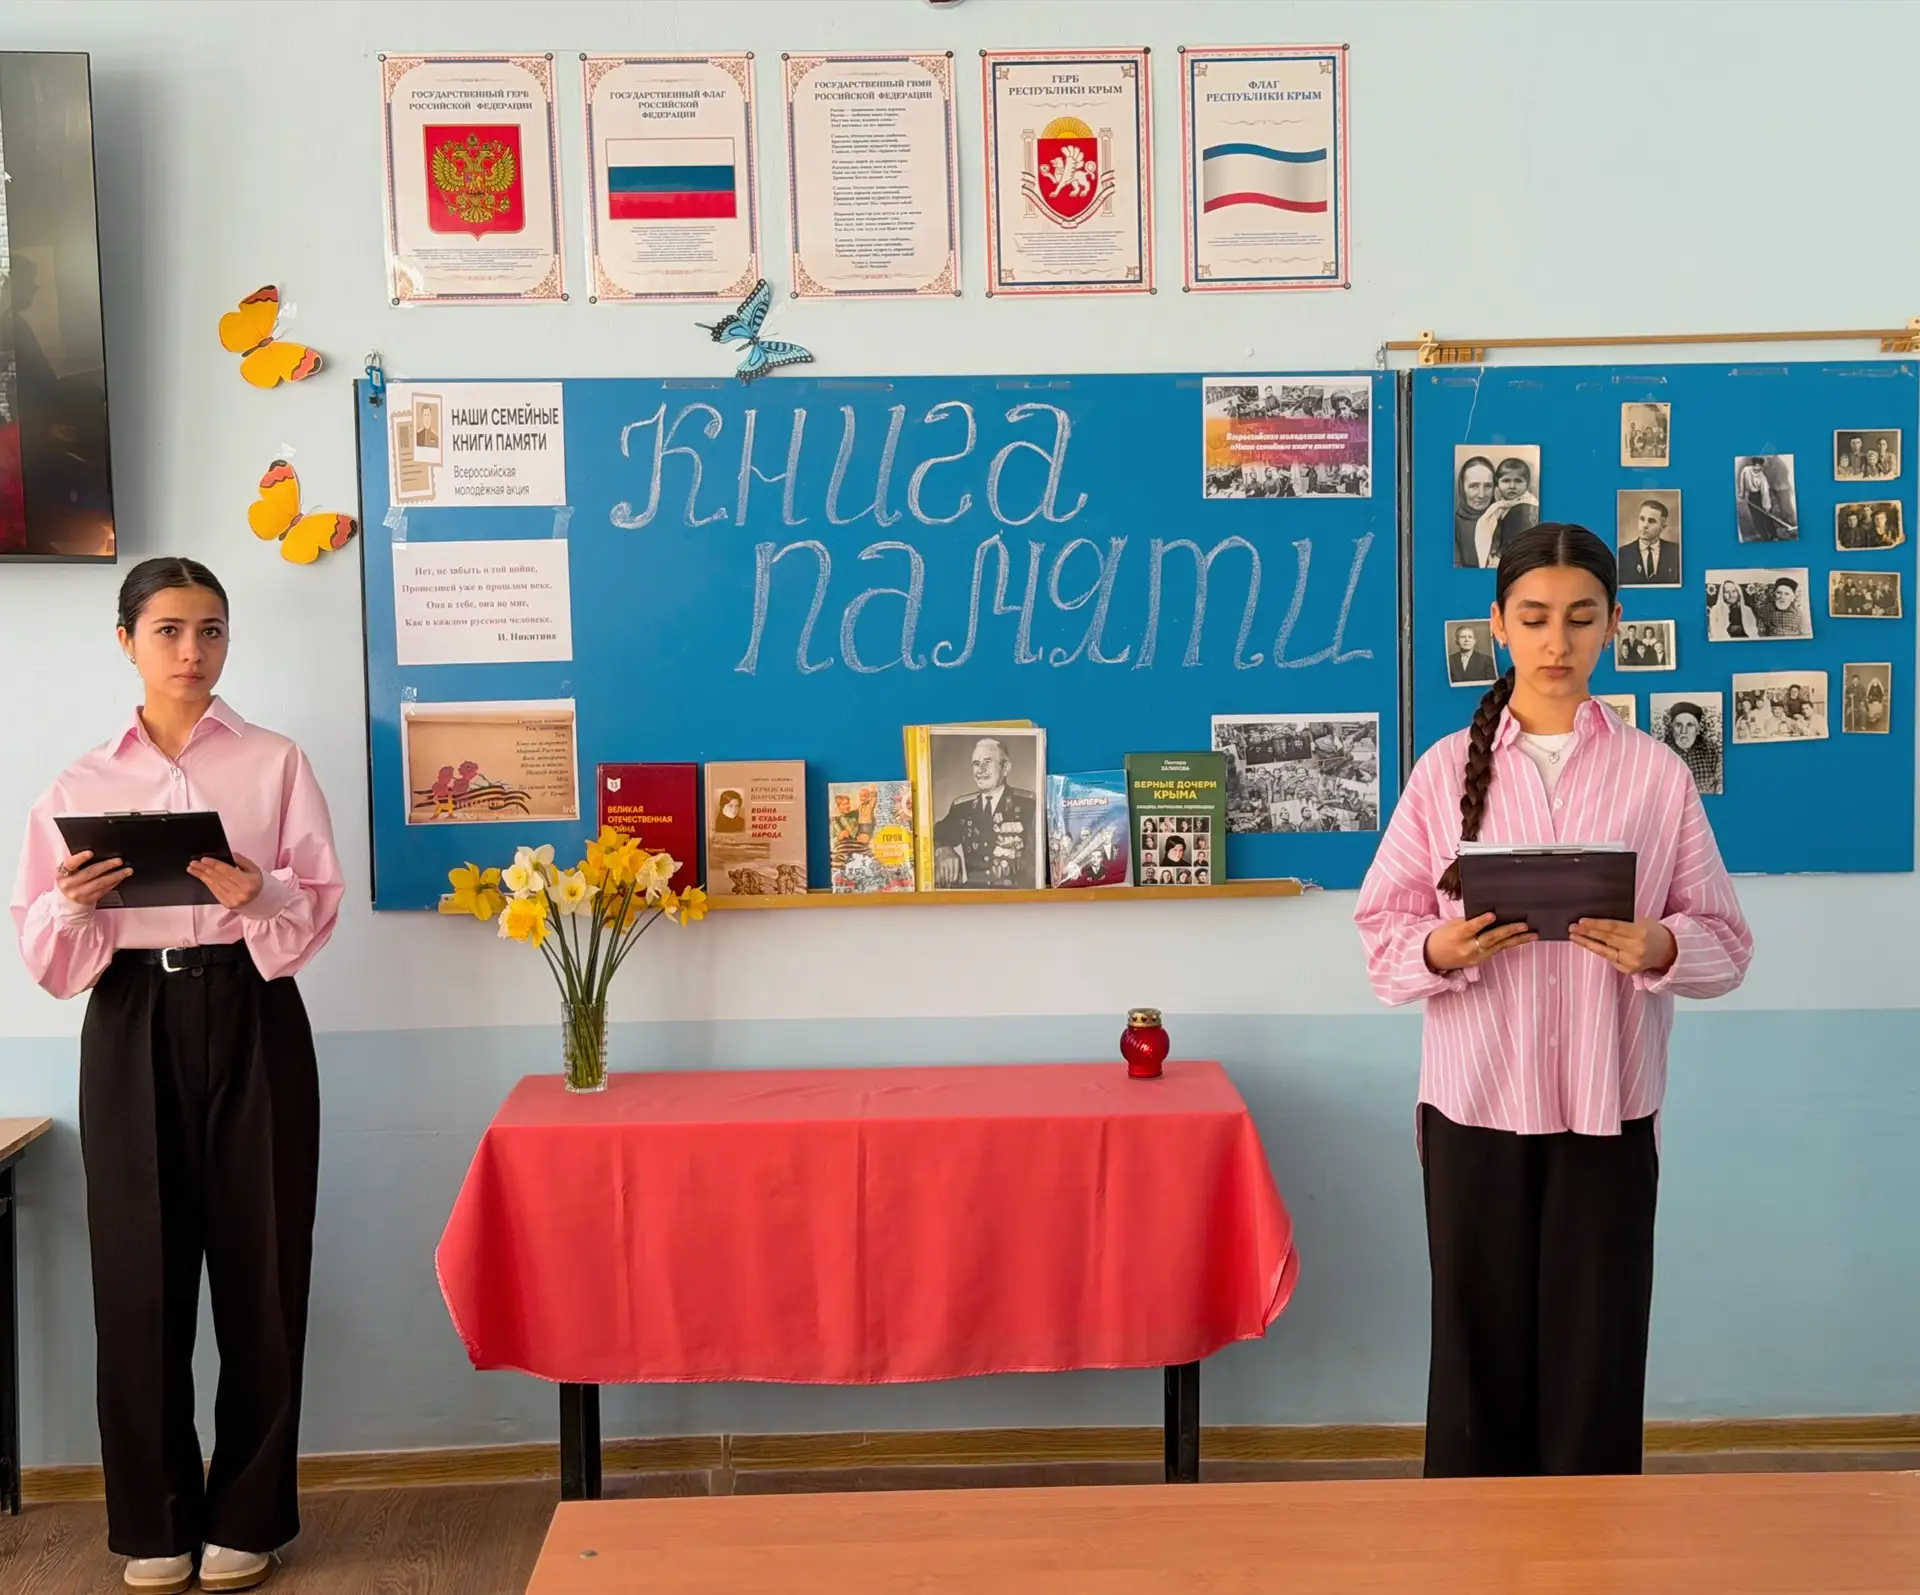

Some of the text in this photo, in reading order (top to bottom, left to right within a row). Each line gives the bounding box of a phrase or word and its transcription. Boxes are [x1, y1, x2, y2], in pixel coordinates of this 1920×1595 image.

[1052, 74, 1080, 84] ГЕРБ
[815, 80, 932, 89] ГОСУДАРСТВЕННЫЙ ГИМН
[1248, 80, 1280, 89] ФЛАГ
[411, 90, 529, 100] ГОСУДАРСТВЕННЫЙ ГЕРБ
[610, 91, 727, 101] ГОСУДАРСТВЕННЫЙ ФЛАГ
[815, 92, 932, 100] РОССИЙСКОЙ ФЕДЕРАЦИИ
[1008, 85, 1123, 97] РЕСПУБЛИКИ КРЫМ
[1206, 91, 1322, 102] РЕСПУБЛИКИ КРЫМ
[409, 101, 533, 111] РОССИЙСКОЙ ФЕДЕРАЦИИ
[638, 100, 699, 109] РОССИЙСКОЙ
[641, 111, 697, 119] ФЕДЕРАЦИИ
[451, 403, 559, 426] НАШИ СЕМЕЙНЫЕ
[452, 433, 547, 452] КНИГИ ПАМЯТИ
[610, 402, 1088, 529] Книга
[453, 465, 516, 480] Всероссийская
[454, 483, 530, 497] молодёжная акция
[415, 566, 435, 576] Нет,
[450, 566, 481, 576] забыть
[491, 566, 506, 574] той
[509, 565, 538, 574] войне,
[402, 584, 456, 594] Прошедшей
[458, 584, 476, 593] уже
[486, 583, 528, 592] прошлом
[426, 601, 445, 609] Она
[509, 600, 529, 608] мне,
[733, 530, 1376, 676] памяти
[405, 619, 423, 627] Как
[433, 618, 468, 626] каждом
[470, 618, 507, 628] русском
[498, 632, 557, 641] И. Никитина
[610, 781, 619, 789] 13
[1134, 780, 1217, 790] ВЕРНЫЕ ДОЧЕРИ
[1154, 790, 1197, 800] КРЫМА
[1061, 797, 1108, 808] СНАЙПЕРЫ
[607, 805, 644, 814] ВЕЛИКАЯ
[607, 815, 673, 824] ОТЕЧЕСТВЕННАЯ
[611, 824, 636, 833] ОЙНА
[751, 831, 782, 839] НАРОДА
